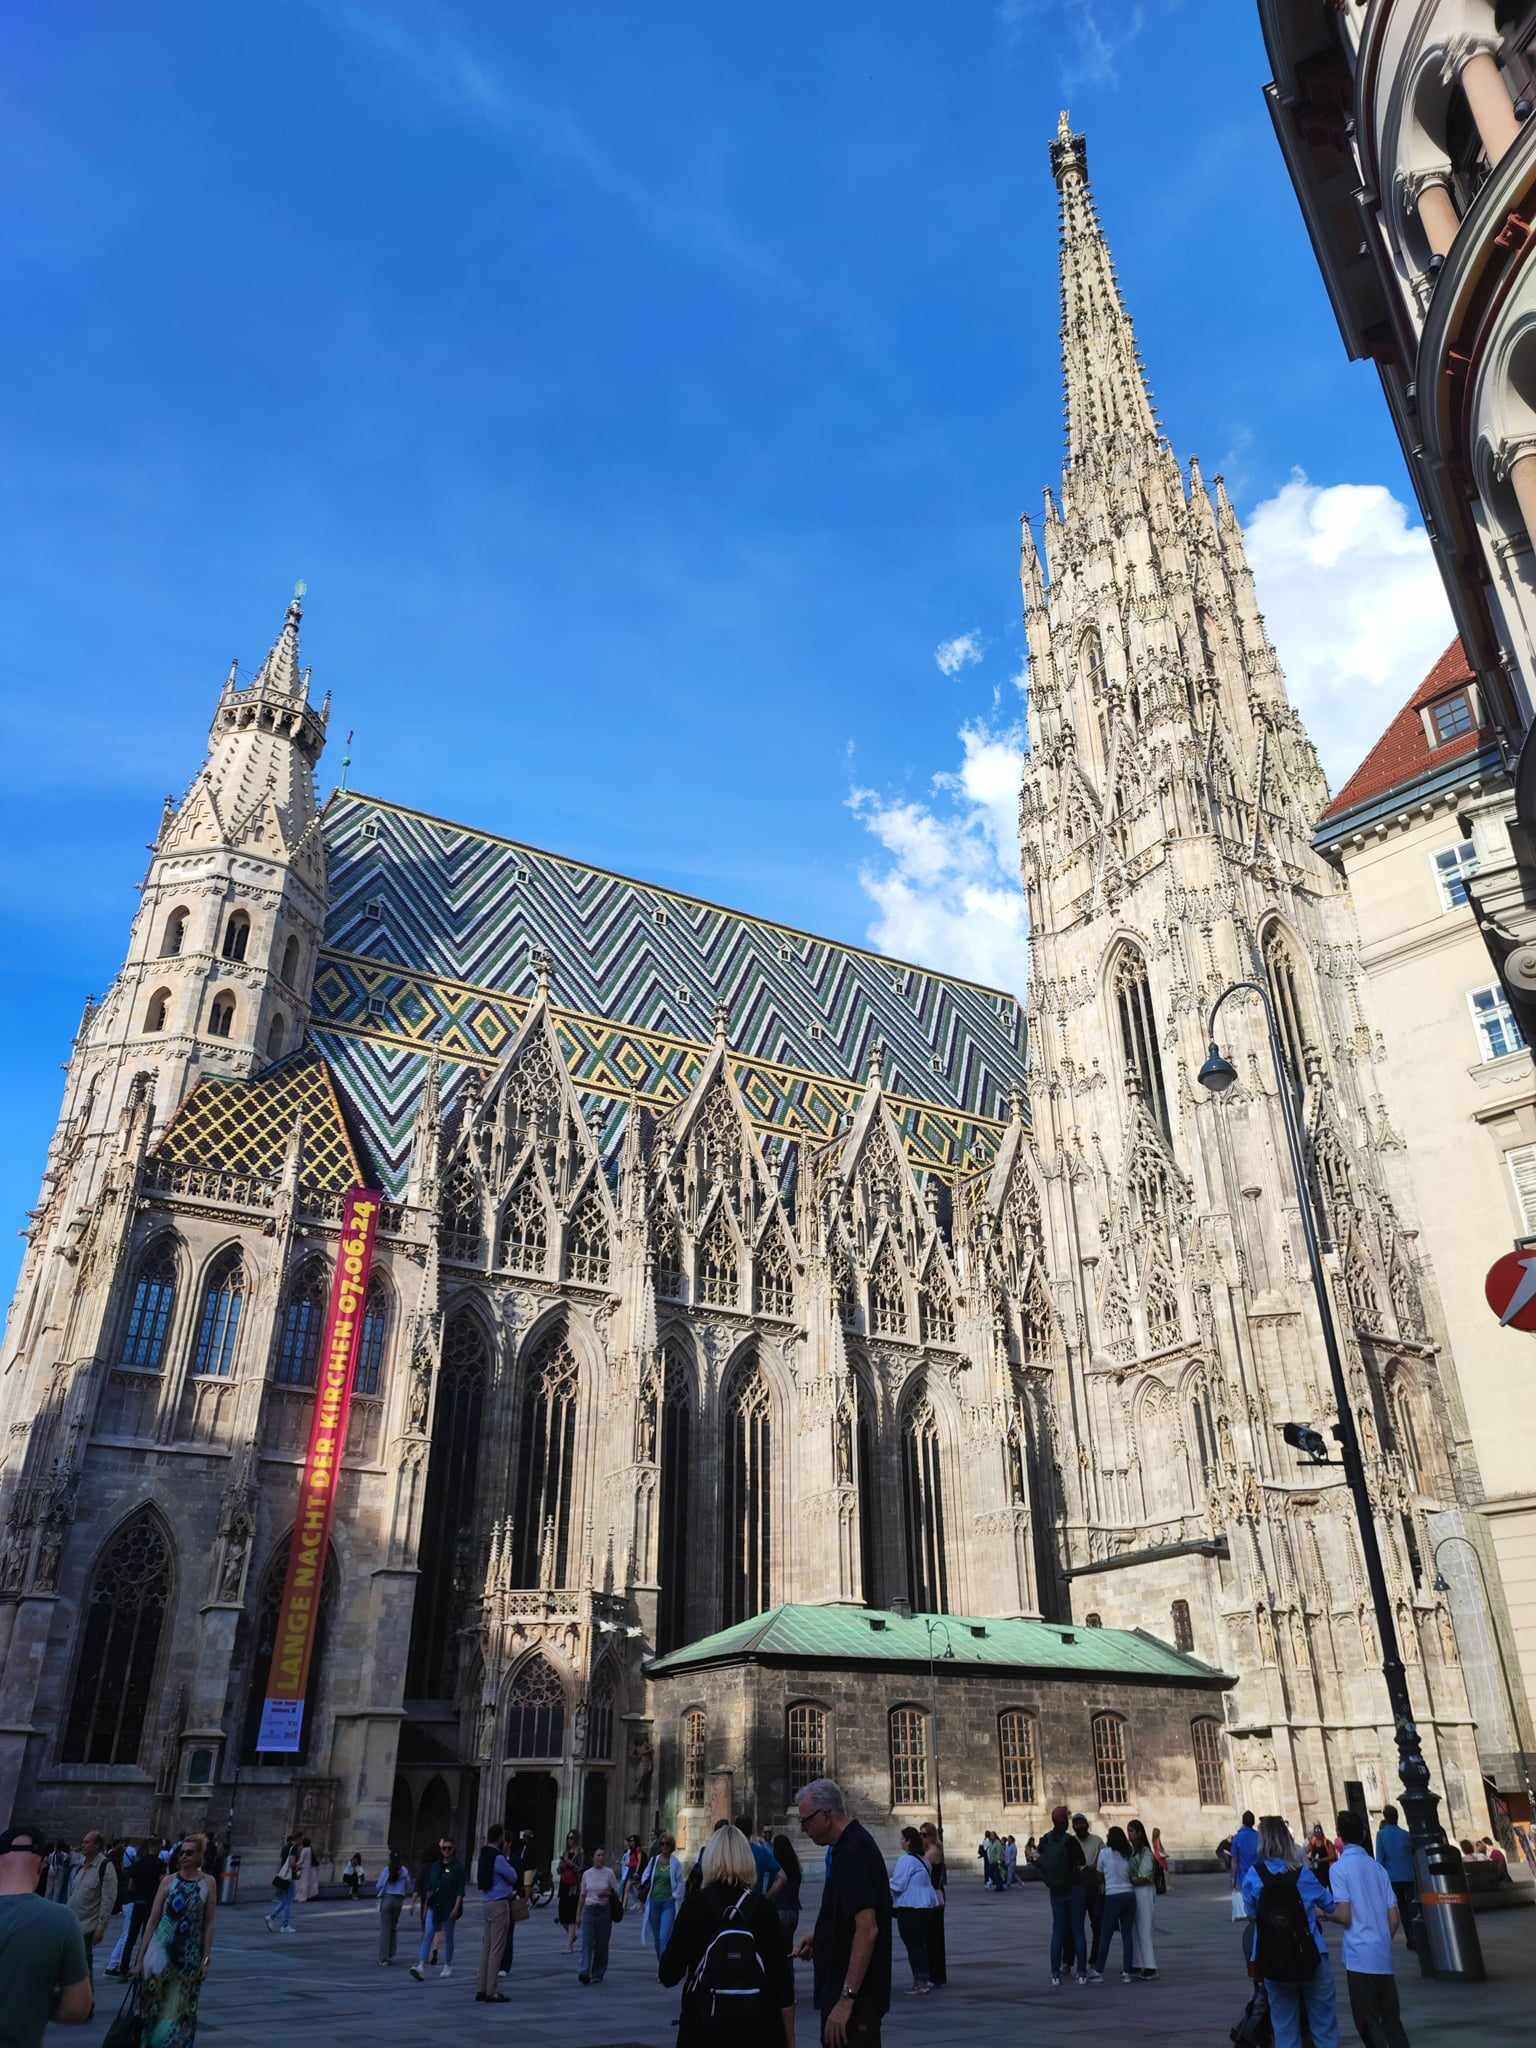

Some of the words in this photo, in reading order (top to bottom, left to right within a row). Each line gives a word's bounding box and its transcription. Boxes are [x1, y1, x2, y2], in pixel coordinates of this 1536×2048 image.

[338, 1201, 376, 1314] 07.06.24
[319, 1320, 353, 1429] KIRCHEN
[310, 1438, 336, 1488] DER
[294, 1495, 327, 1587] NACHT
[277, 1597, 311, 1689] LANGE
